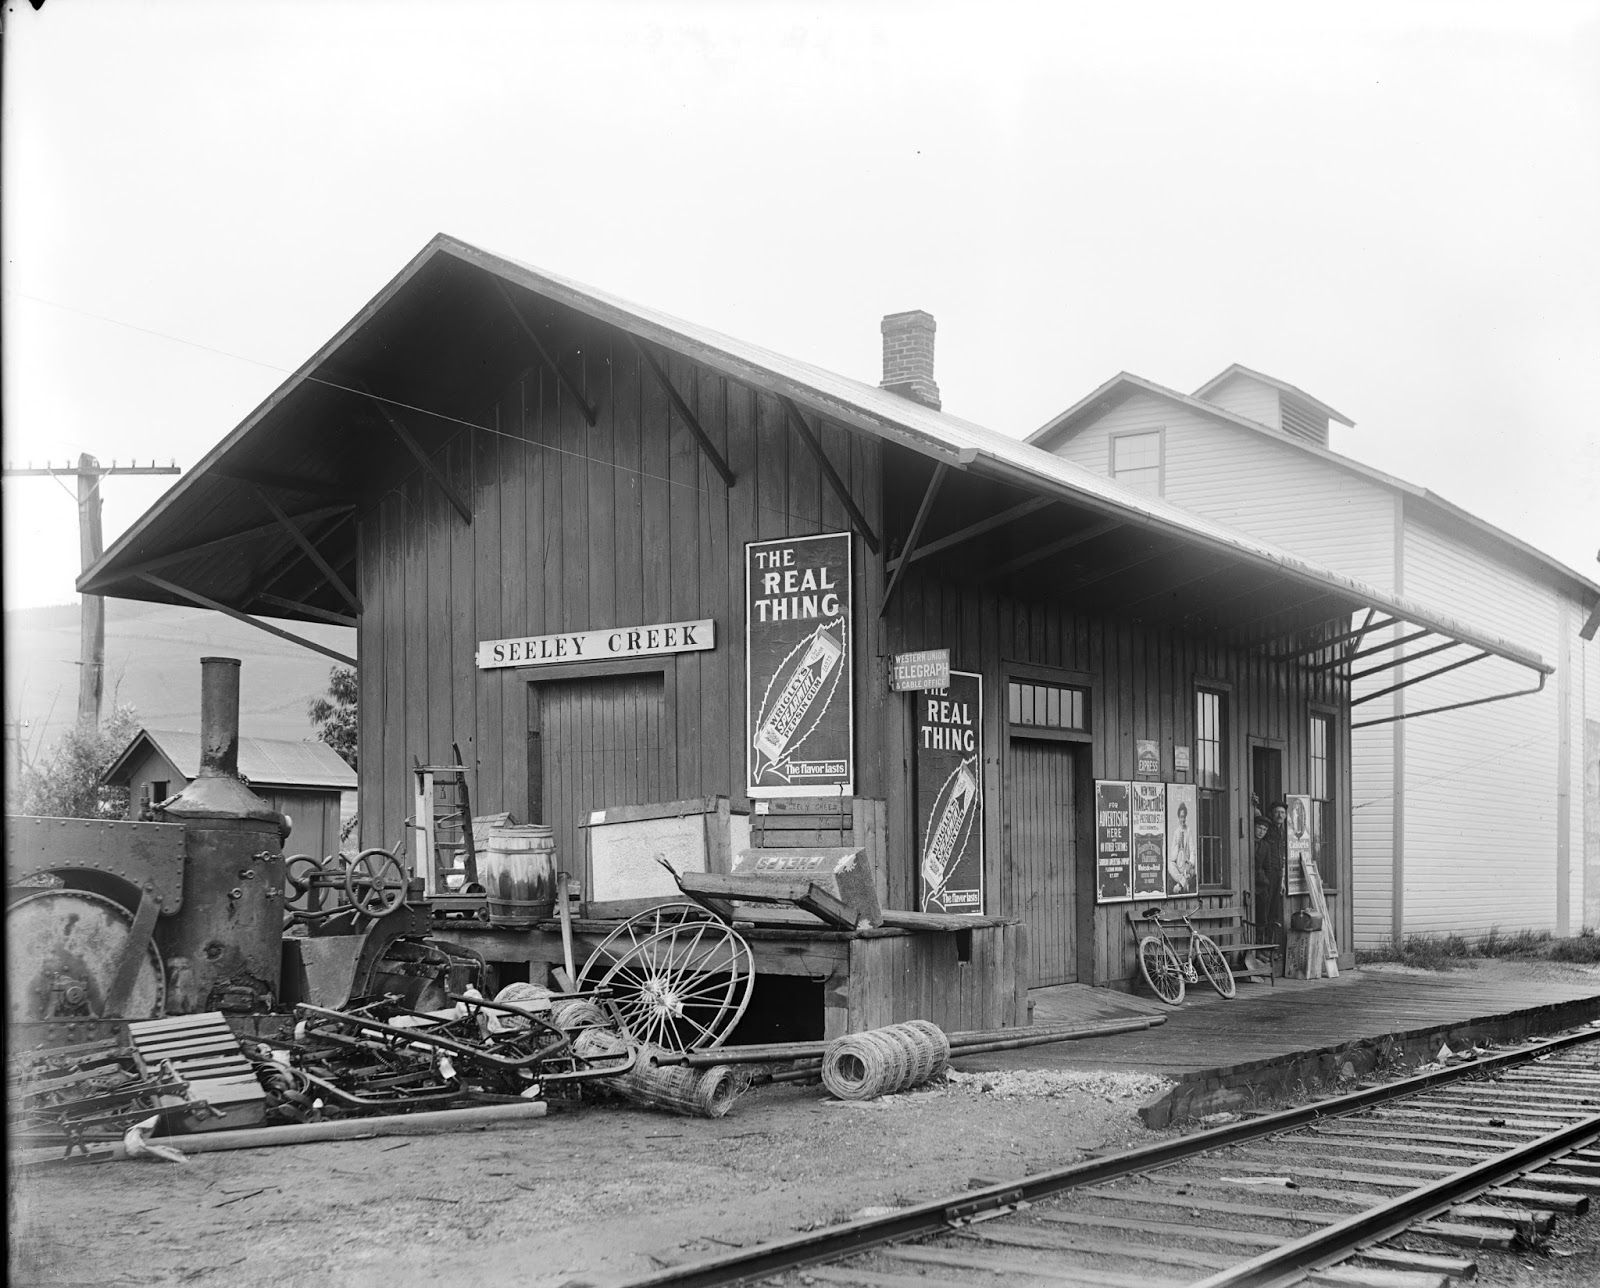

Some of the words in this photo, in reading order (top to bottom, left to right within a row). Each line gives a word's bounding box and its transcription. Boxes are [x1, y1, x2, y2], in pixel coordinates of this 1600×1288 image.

[755, 549, 795, 569] THE
[764, 567, 836, 594] REAL
[754, 593, 839, 622] THING
[493, 636, 586, 662] SEELEY
[608, 625, 698, 652] CREEK
[895, 652, 926, 664] WESTERN
[927, 650, 947, 661] UNION
[893, 662, 949, 679] TELEGRAPH
[896, 681, 900, 690] &
[901, 680, 921, 689] CABLE
[923, 678, 946, 688] OFFICE
[770, 666, 808, 727] WRIGLEY'S
[775, 669, 816, 736] SPEARMINT
[783, 701, 808, 739] PEPSIN
[807, 677, 822, 702] GUM
[928, 700, 972, 725] REAL
[921, 725, 975, 752] THING
[785, 764, 801, 775] The
[801, 764, 824, 774] flavor
[825, 763, 845, 773] lasts
[1138, 760, 1158, 772] EXPRESS
[1099, 811, 1128, 827] ADVERTISING
[1106, 827, 1122, 838] HERE
[756, 856, 824, 870] PHELPS
